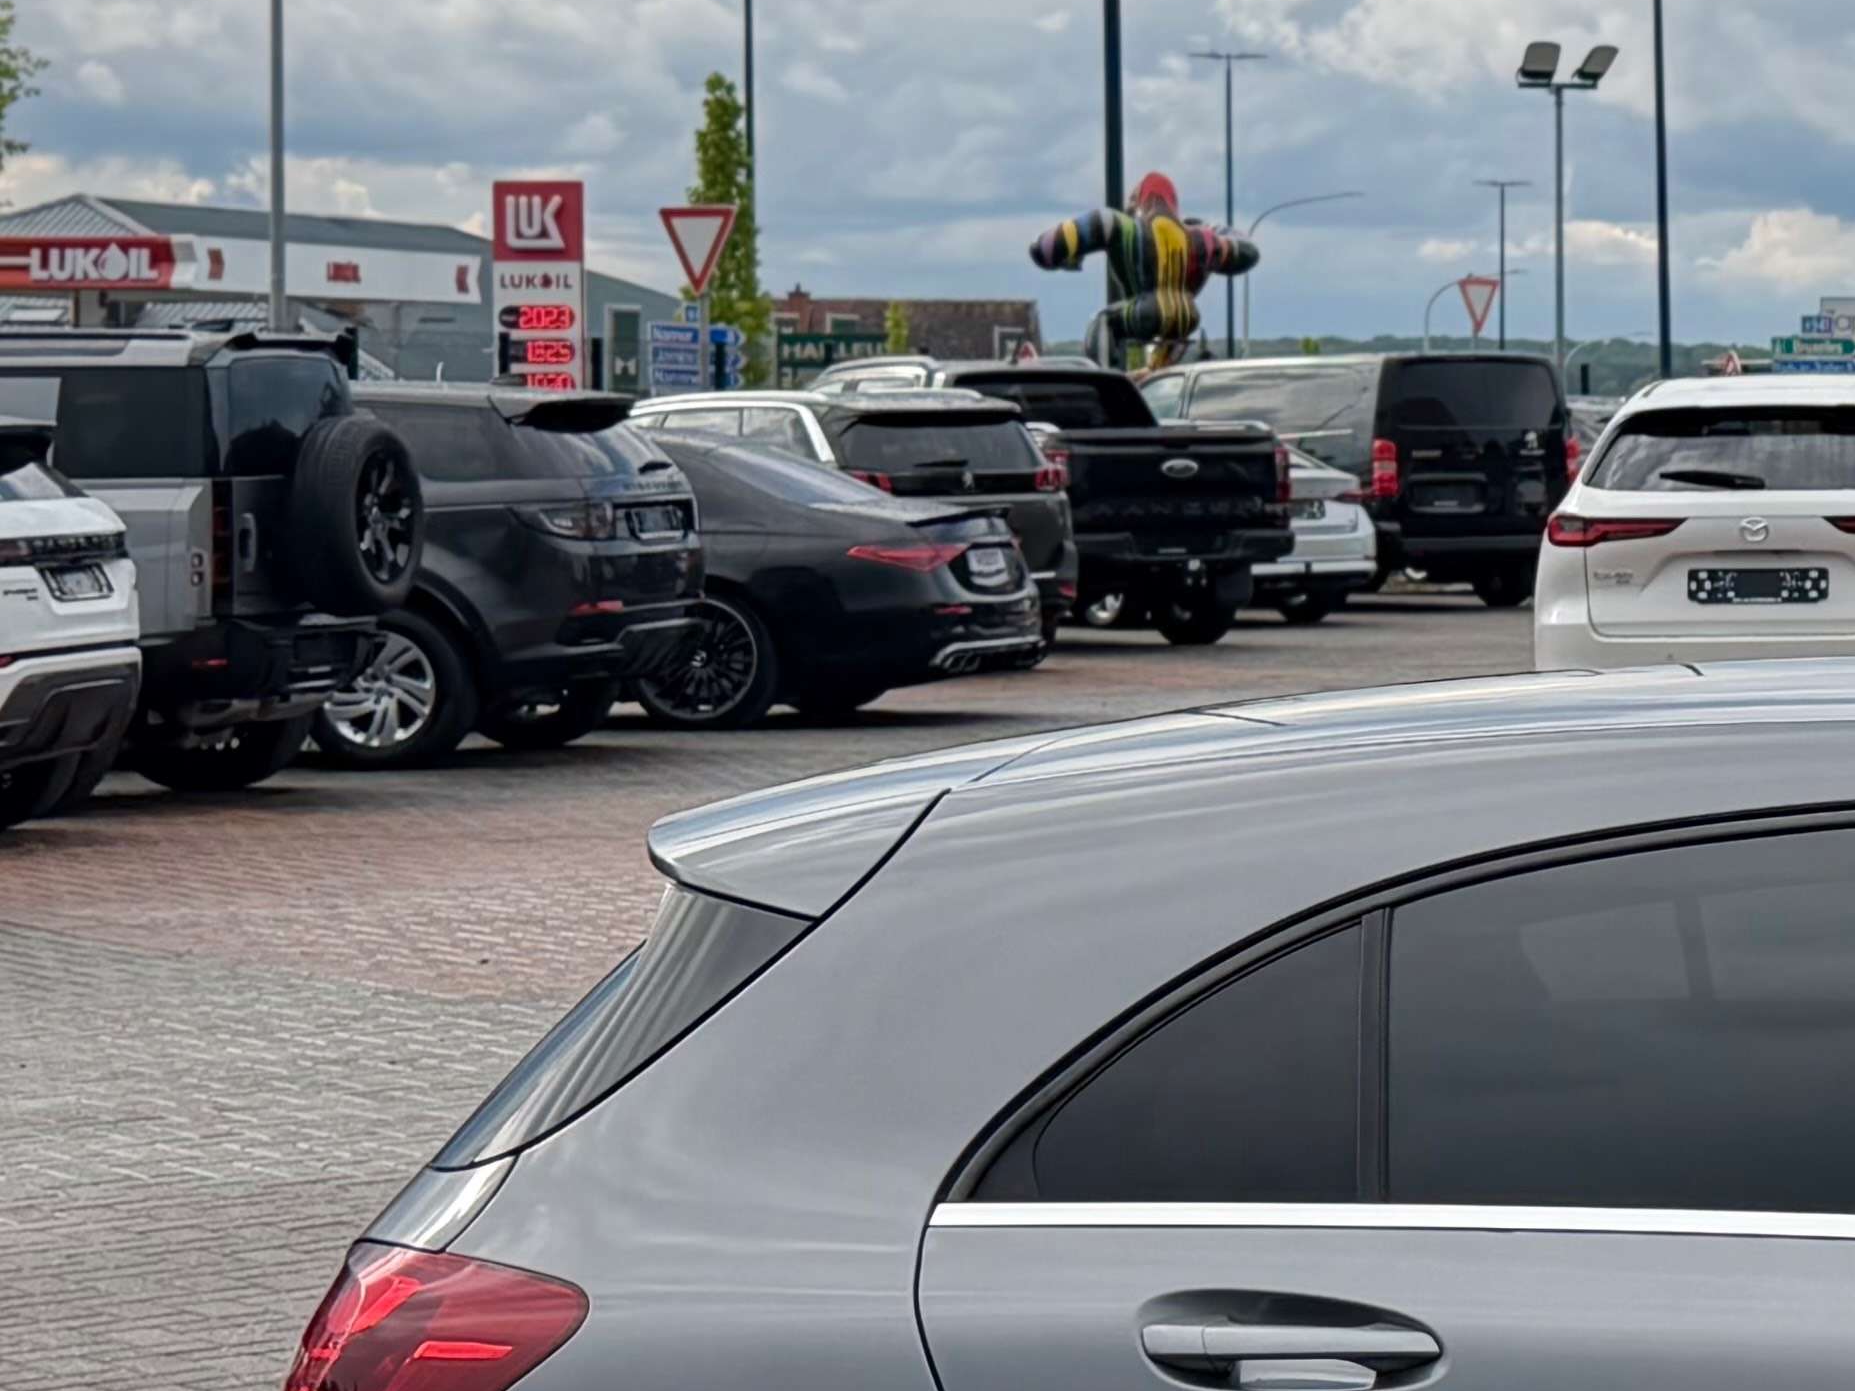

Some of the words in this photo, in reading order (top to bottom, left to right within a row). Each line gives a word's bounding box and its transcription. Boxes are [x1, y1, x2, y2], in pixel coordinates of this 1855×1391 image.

[505, 194, 566, 250] LUK
[30, 242, 159, 281] LUKOIL
[500, 273, 573, 289] LUKOIL
